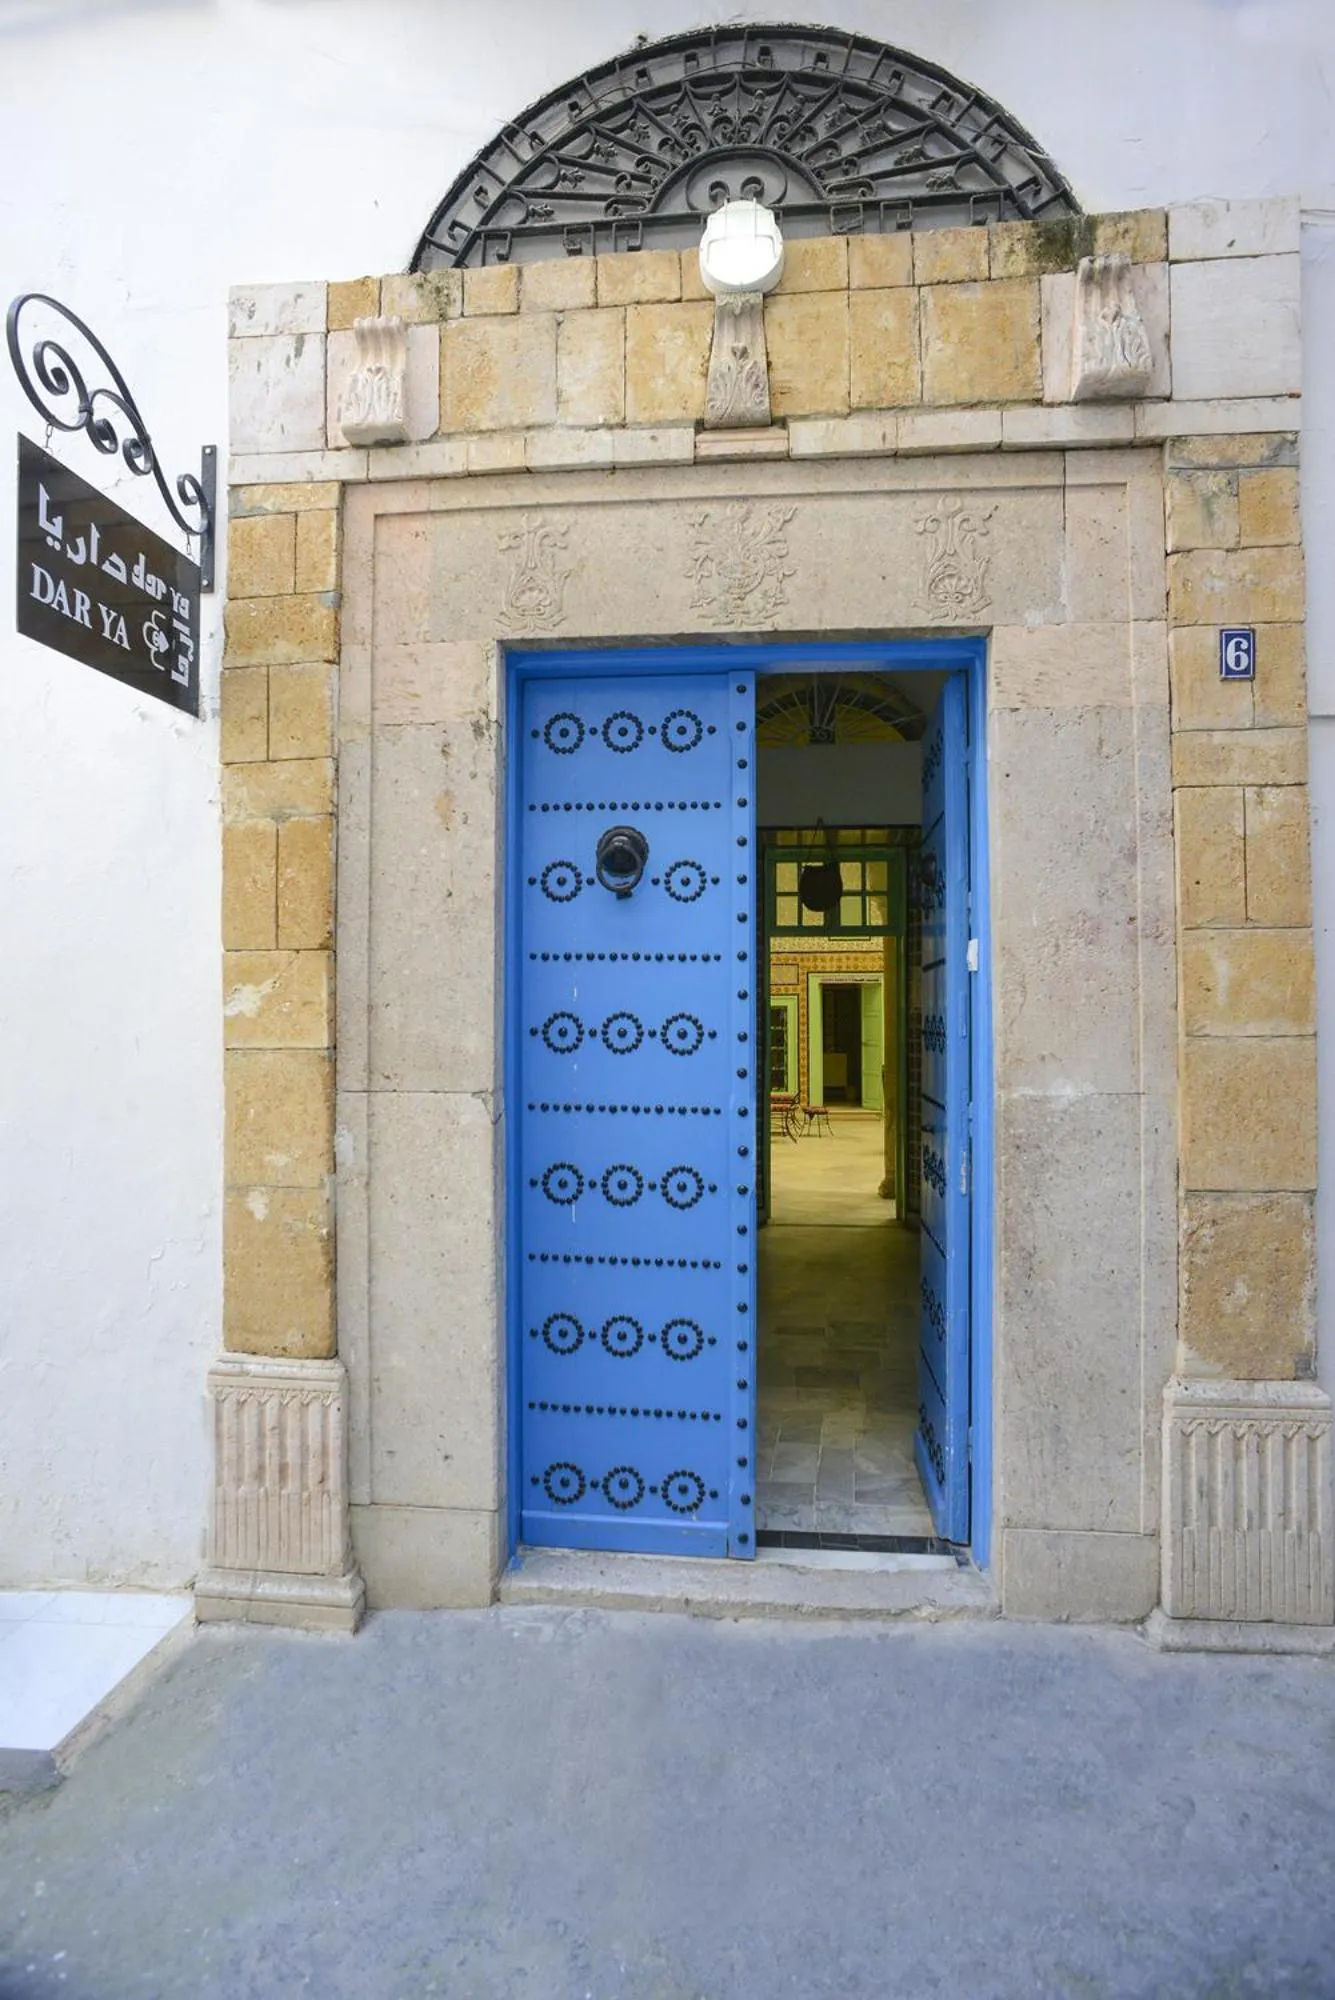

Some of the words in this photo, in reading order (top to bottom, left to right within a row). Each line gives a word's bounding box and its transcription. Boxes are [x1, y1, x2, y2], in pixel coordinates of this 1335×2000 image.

[30, 562, 93, 629] DAR
[98, 602, 131, 651] YA
[1226, 637, 1249, 671] 6
